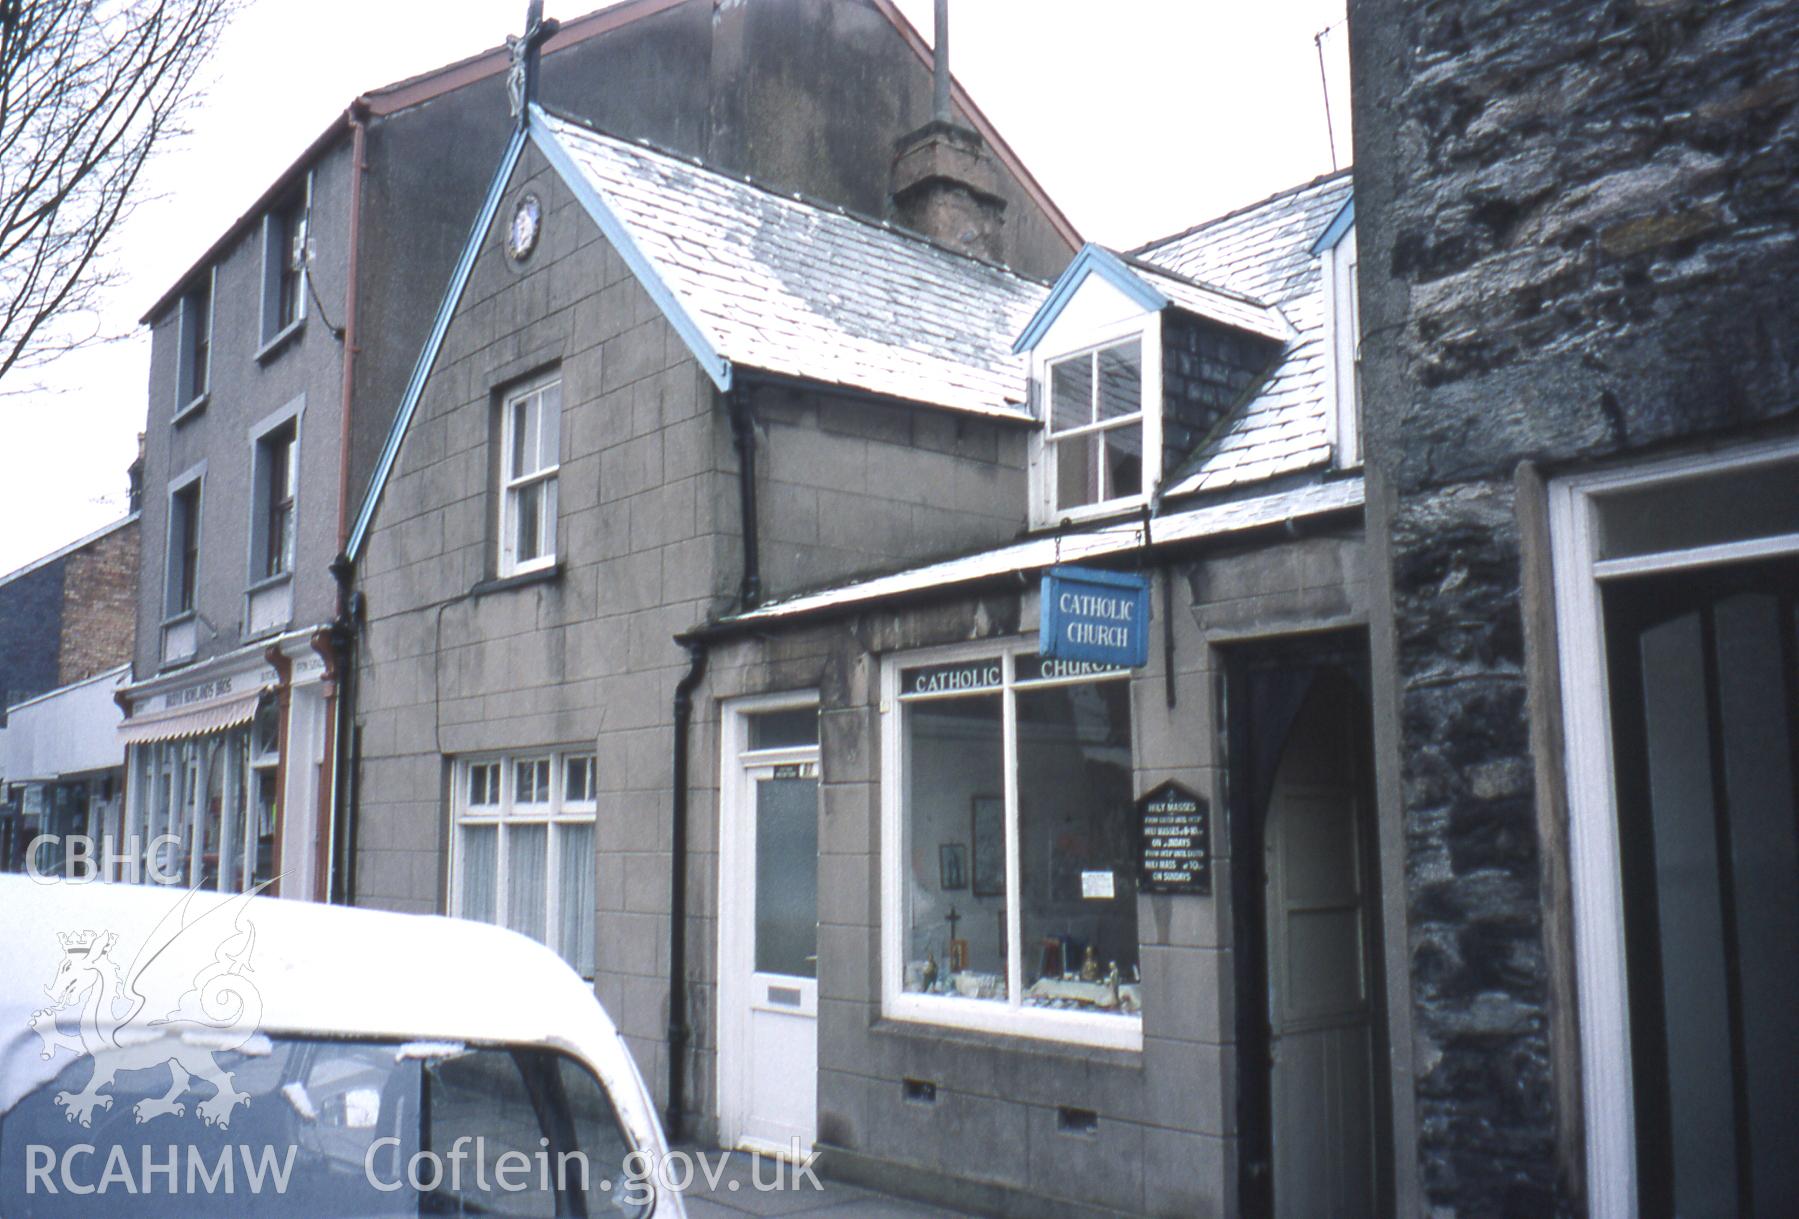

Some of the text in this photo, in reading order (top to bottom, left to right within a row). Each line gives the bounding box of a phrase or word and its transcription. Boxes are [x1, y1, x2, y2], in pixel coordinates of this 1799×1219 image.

[1060, 593, 1135, 621] CATHOLIC
[1067, 622, 1128, 647] CHURCH
[916, 667, 999, 692] CATHOLIC
[1167, 802, 1196, 812] MASSES
